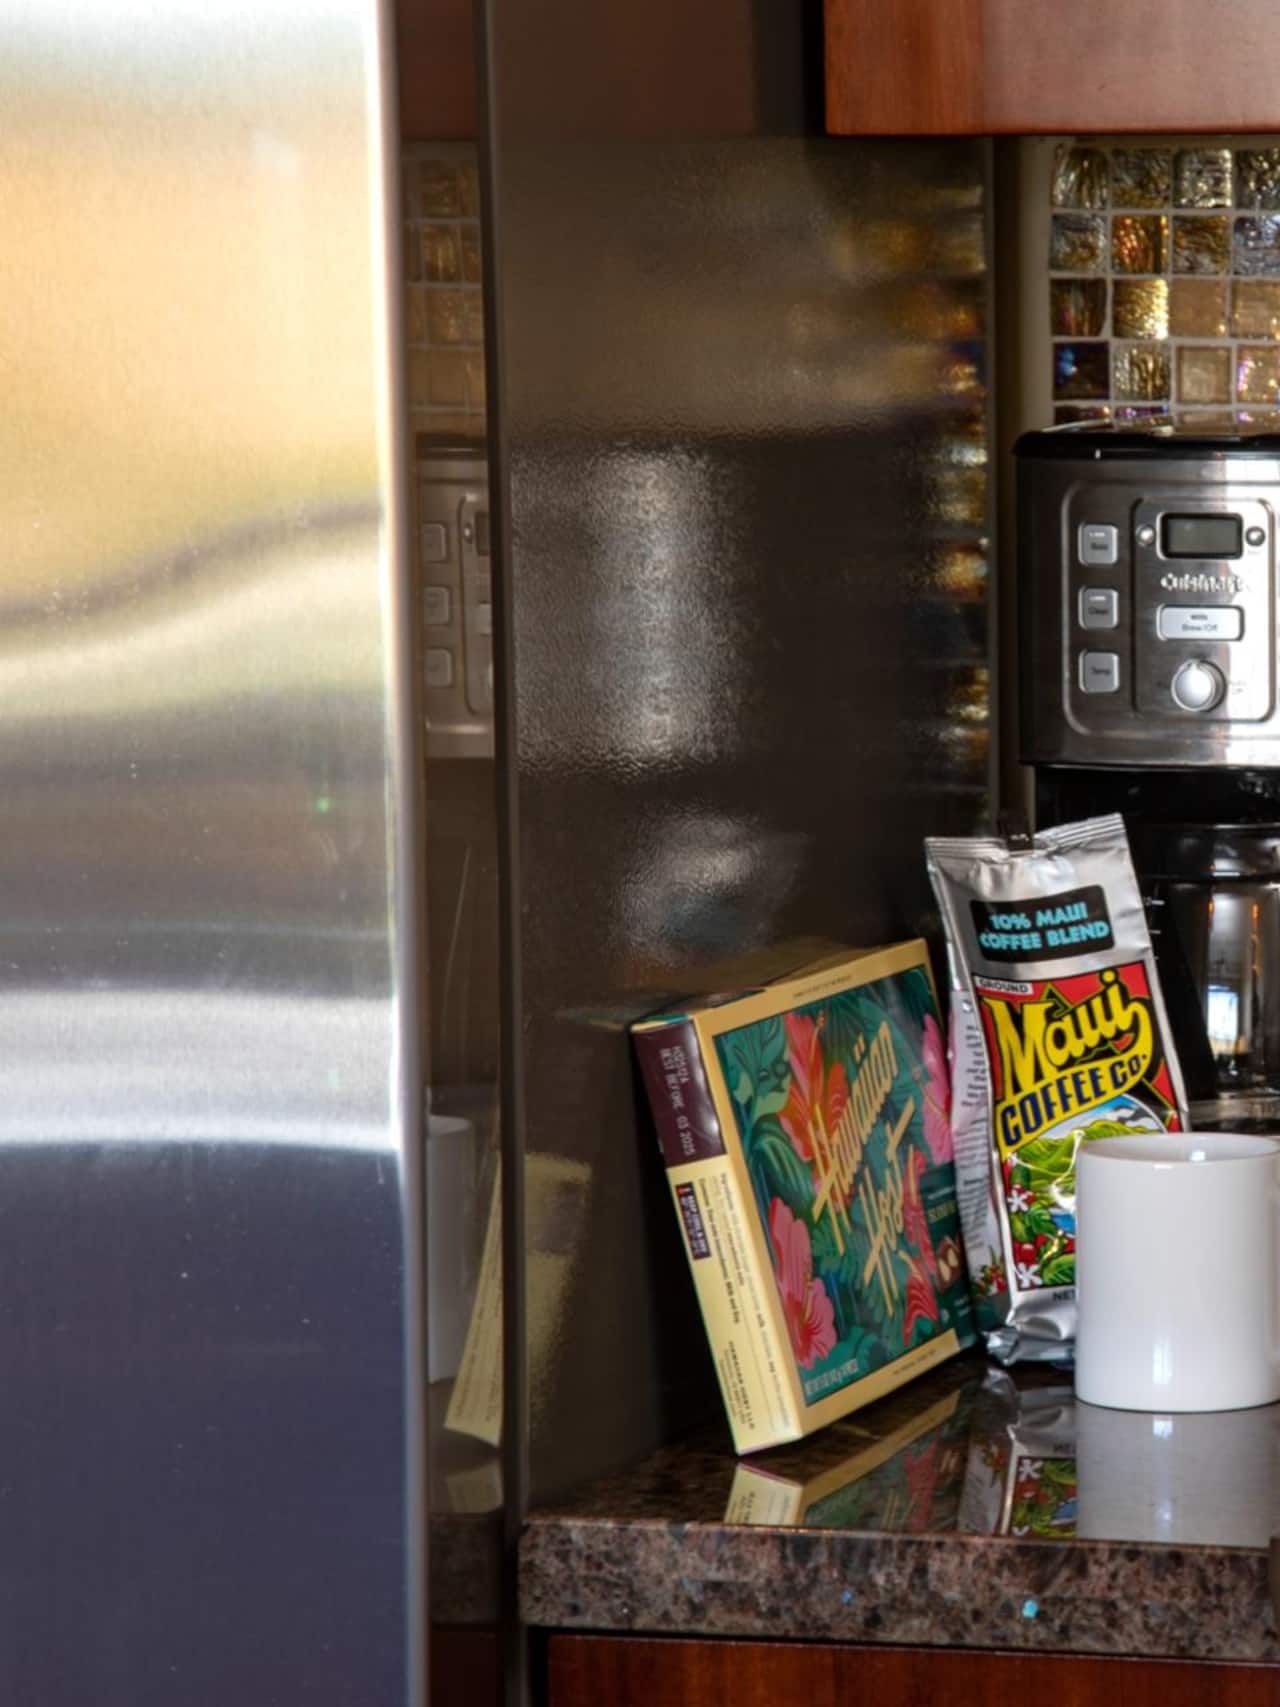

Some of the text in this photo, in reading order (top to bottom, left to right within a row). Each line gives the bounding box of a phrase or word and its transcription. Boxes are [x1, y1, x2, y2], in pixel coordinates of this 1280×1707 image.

[989, 902, 1088, 930] 10% MAUI
[979, 921, 1110, 950] COFFEE BLEND
[978, 978, 1029, 993] GROUND
[983, 969, 1149, 1100] Maui
[1001, 1070, 1107, 1147] COFFEE
